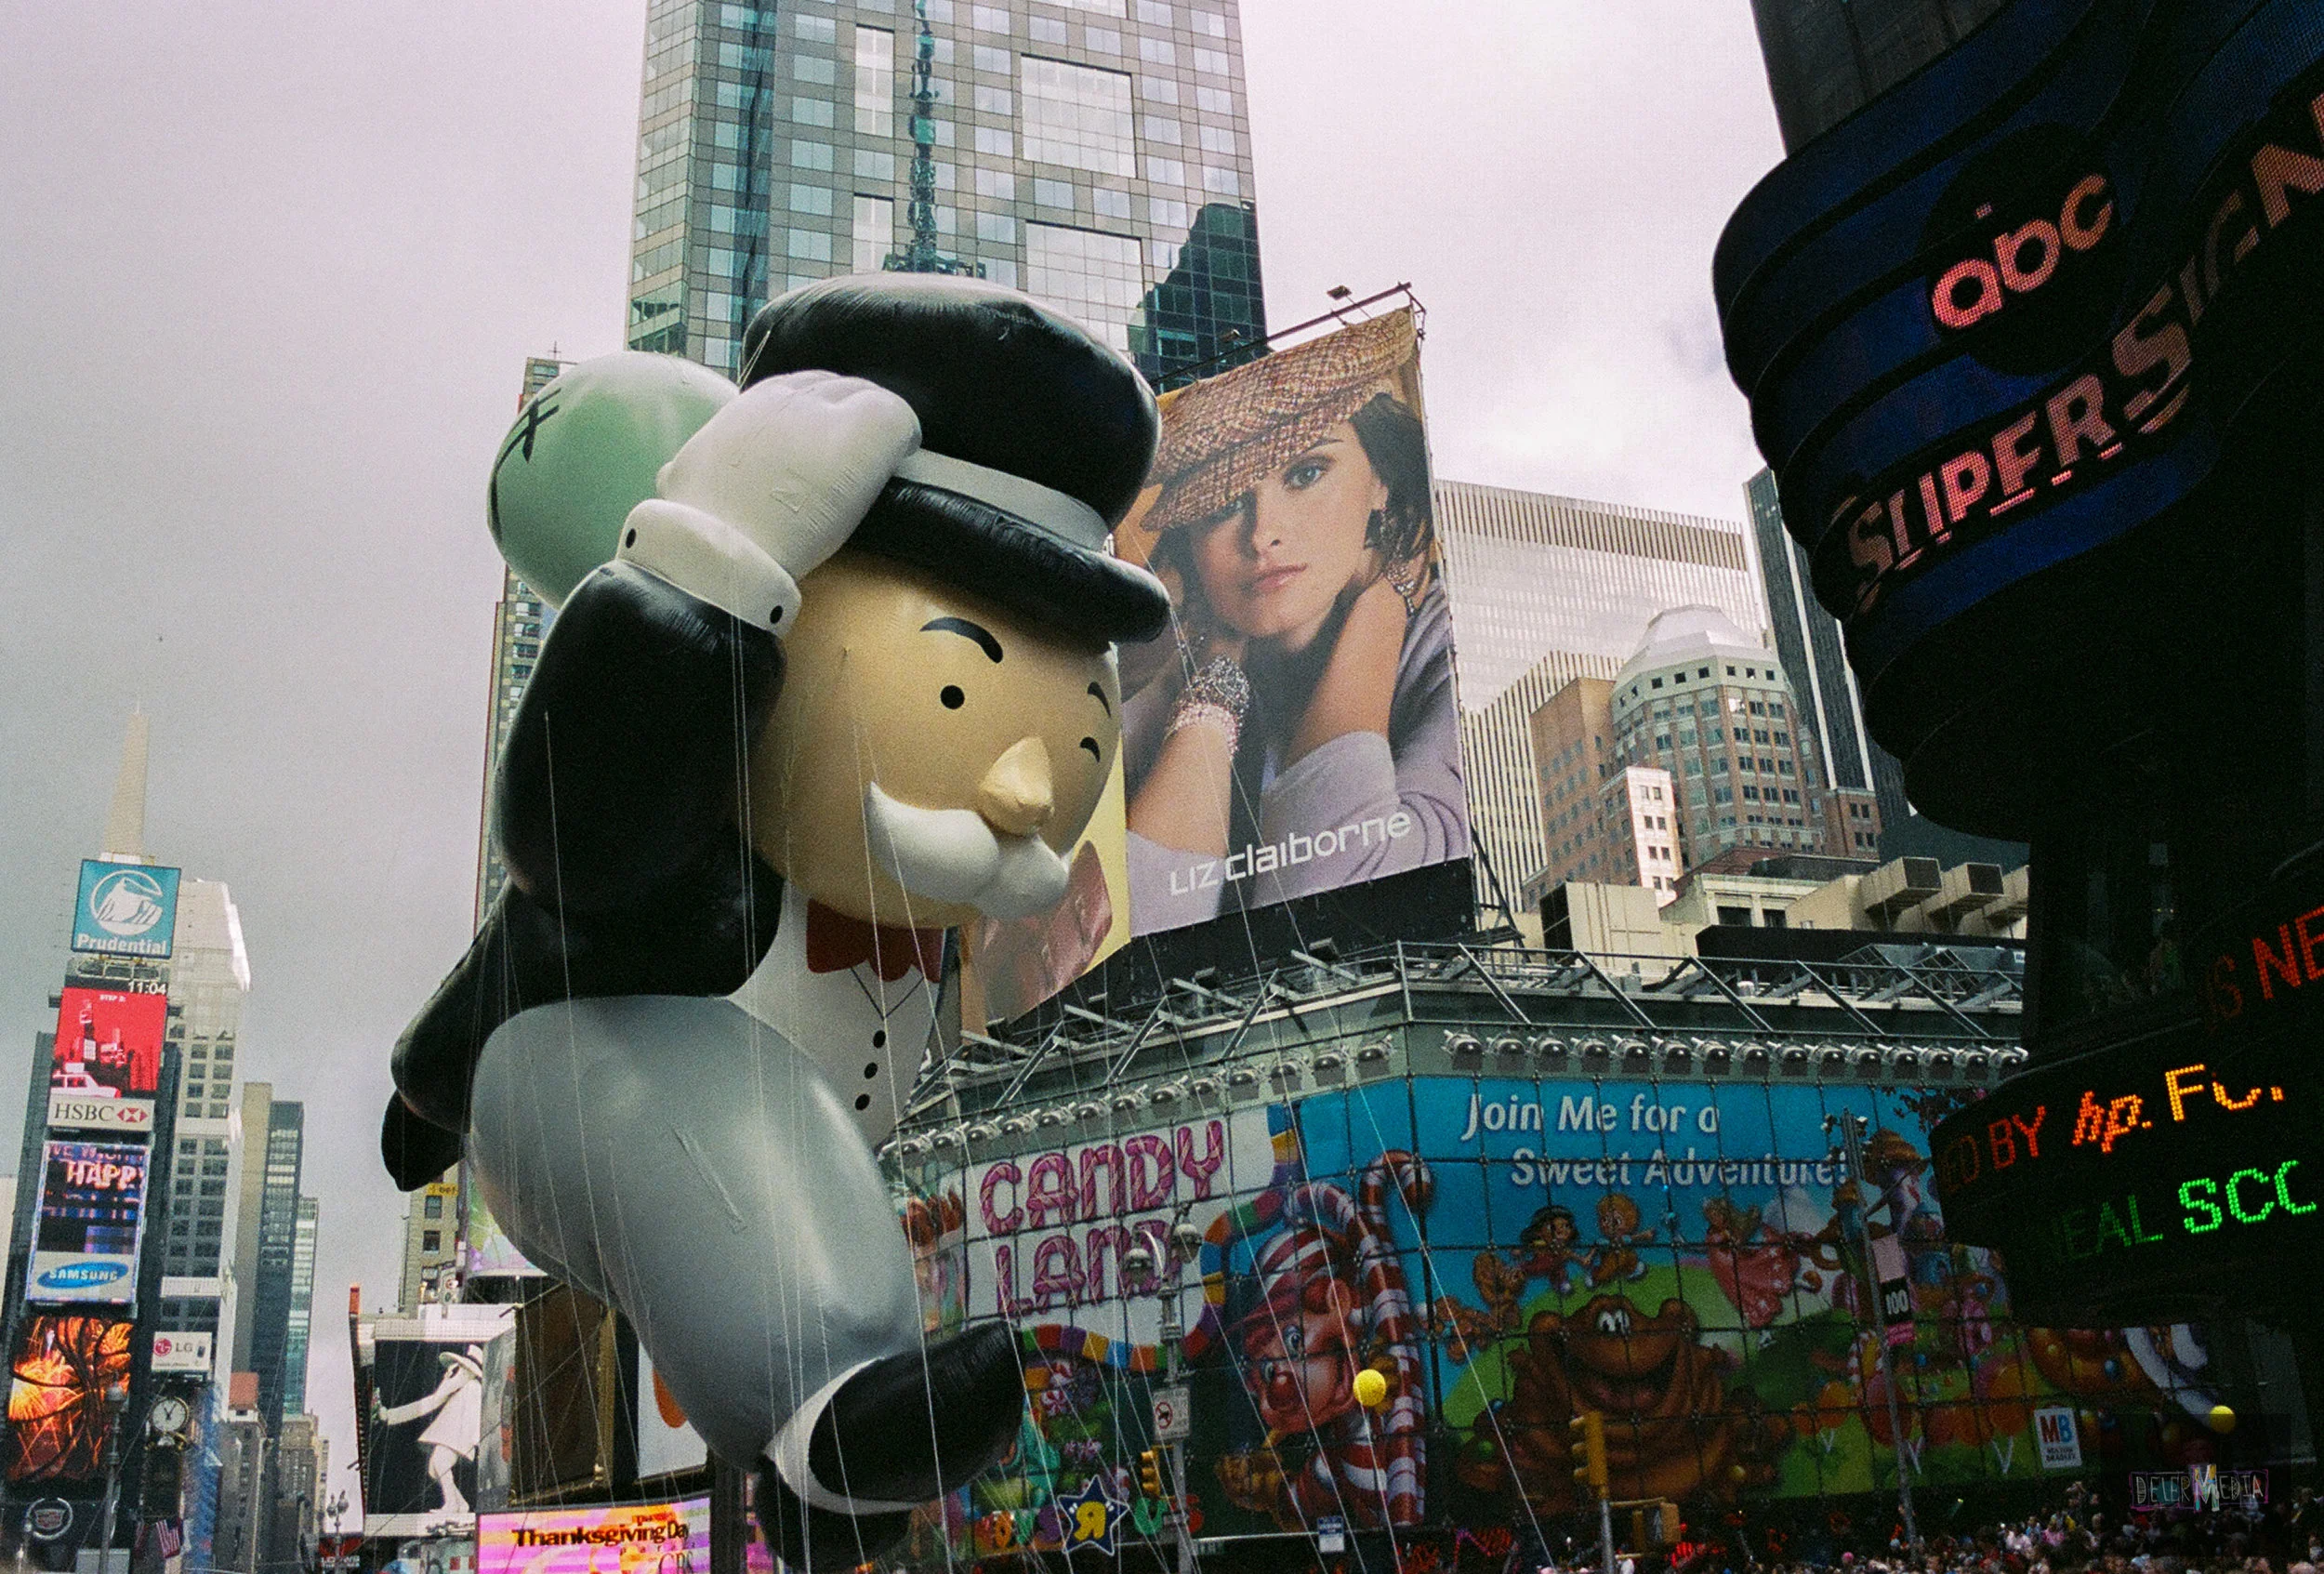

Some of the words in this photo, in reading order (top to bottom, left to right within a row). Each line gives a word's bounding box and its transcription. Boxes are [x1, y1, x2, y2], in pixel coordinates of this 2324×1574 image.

[1932, 173, 2114, 329] abc
[1224, 811, 1411, 881] claiborne
[76, 932, 167, 955] Prudential
[127, 980, 167, 995] 11:04
[54, 1103, 114, 1122] HSBC
[1460, 1093, 1543, 1142] Join
[1558, 1095, 1618, 1132] Me
[1630, 1092, 1686, 1133] for
[1697, 1104, 1721, 1133] a
[1987, 1104, 2047, 1171] BY
[980, 1119, 1224, 1235] CANDY
[1511, 1146, 1632, 1187] Sweet
[1644, 1146, 1848, 1187] Adventure!
[48, 1268, 118, 1281] SAMSUNG
[996, 1219, 1183, 1316] LAND
[175, 1343, 193, 1353] LG
[2040, 1414, 2072, 1443] MB
[512, 1523, 667, 1547] Thanksgiving
